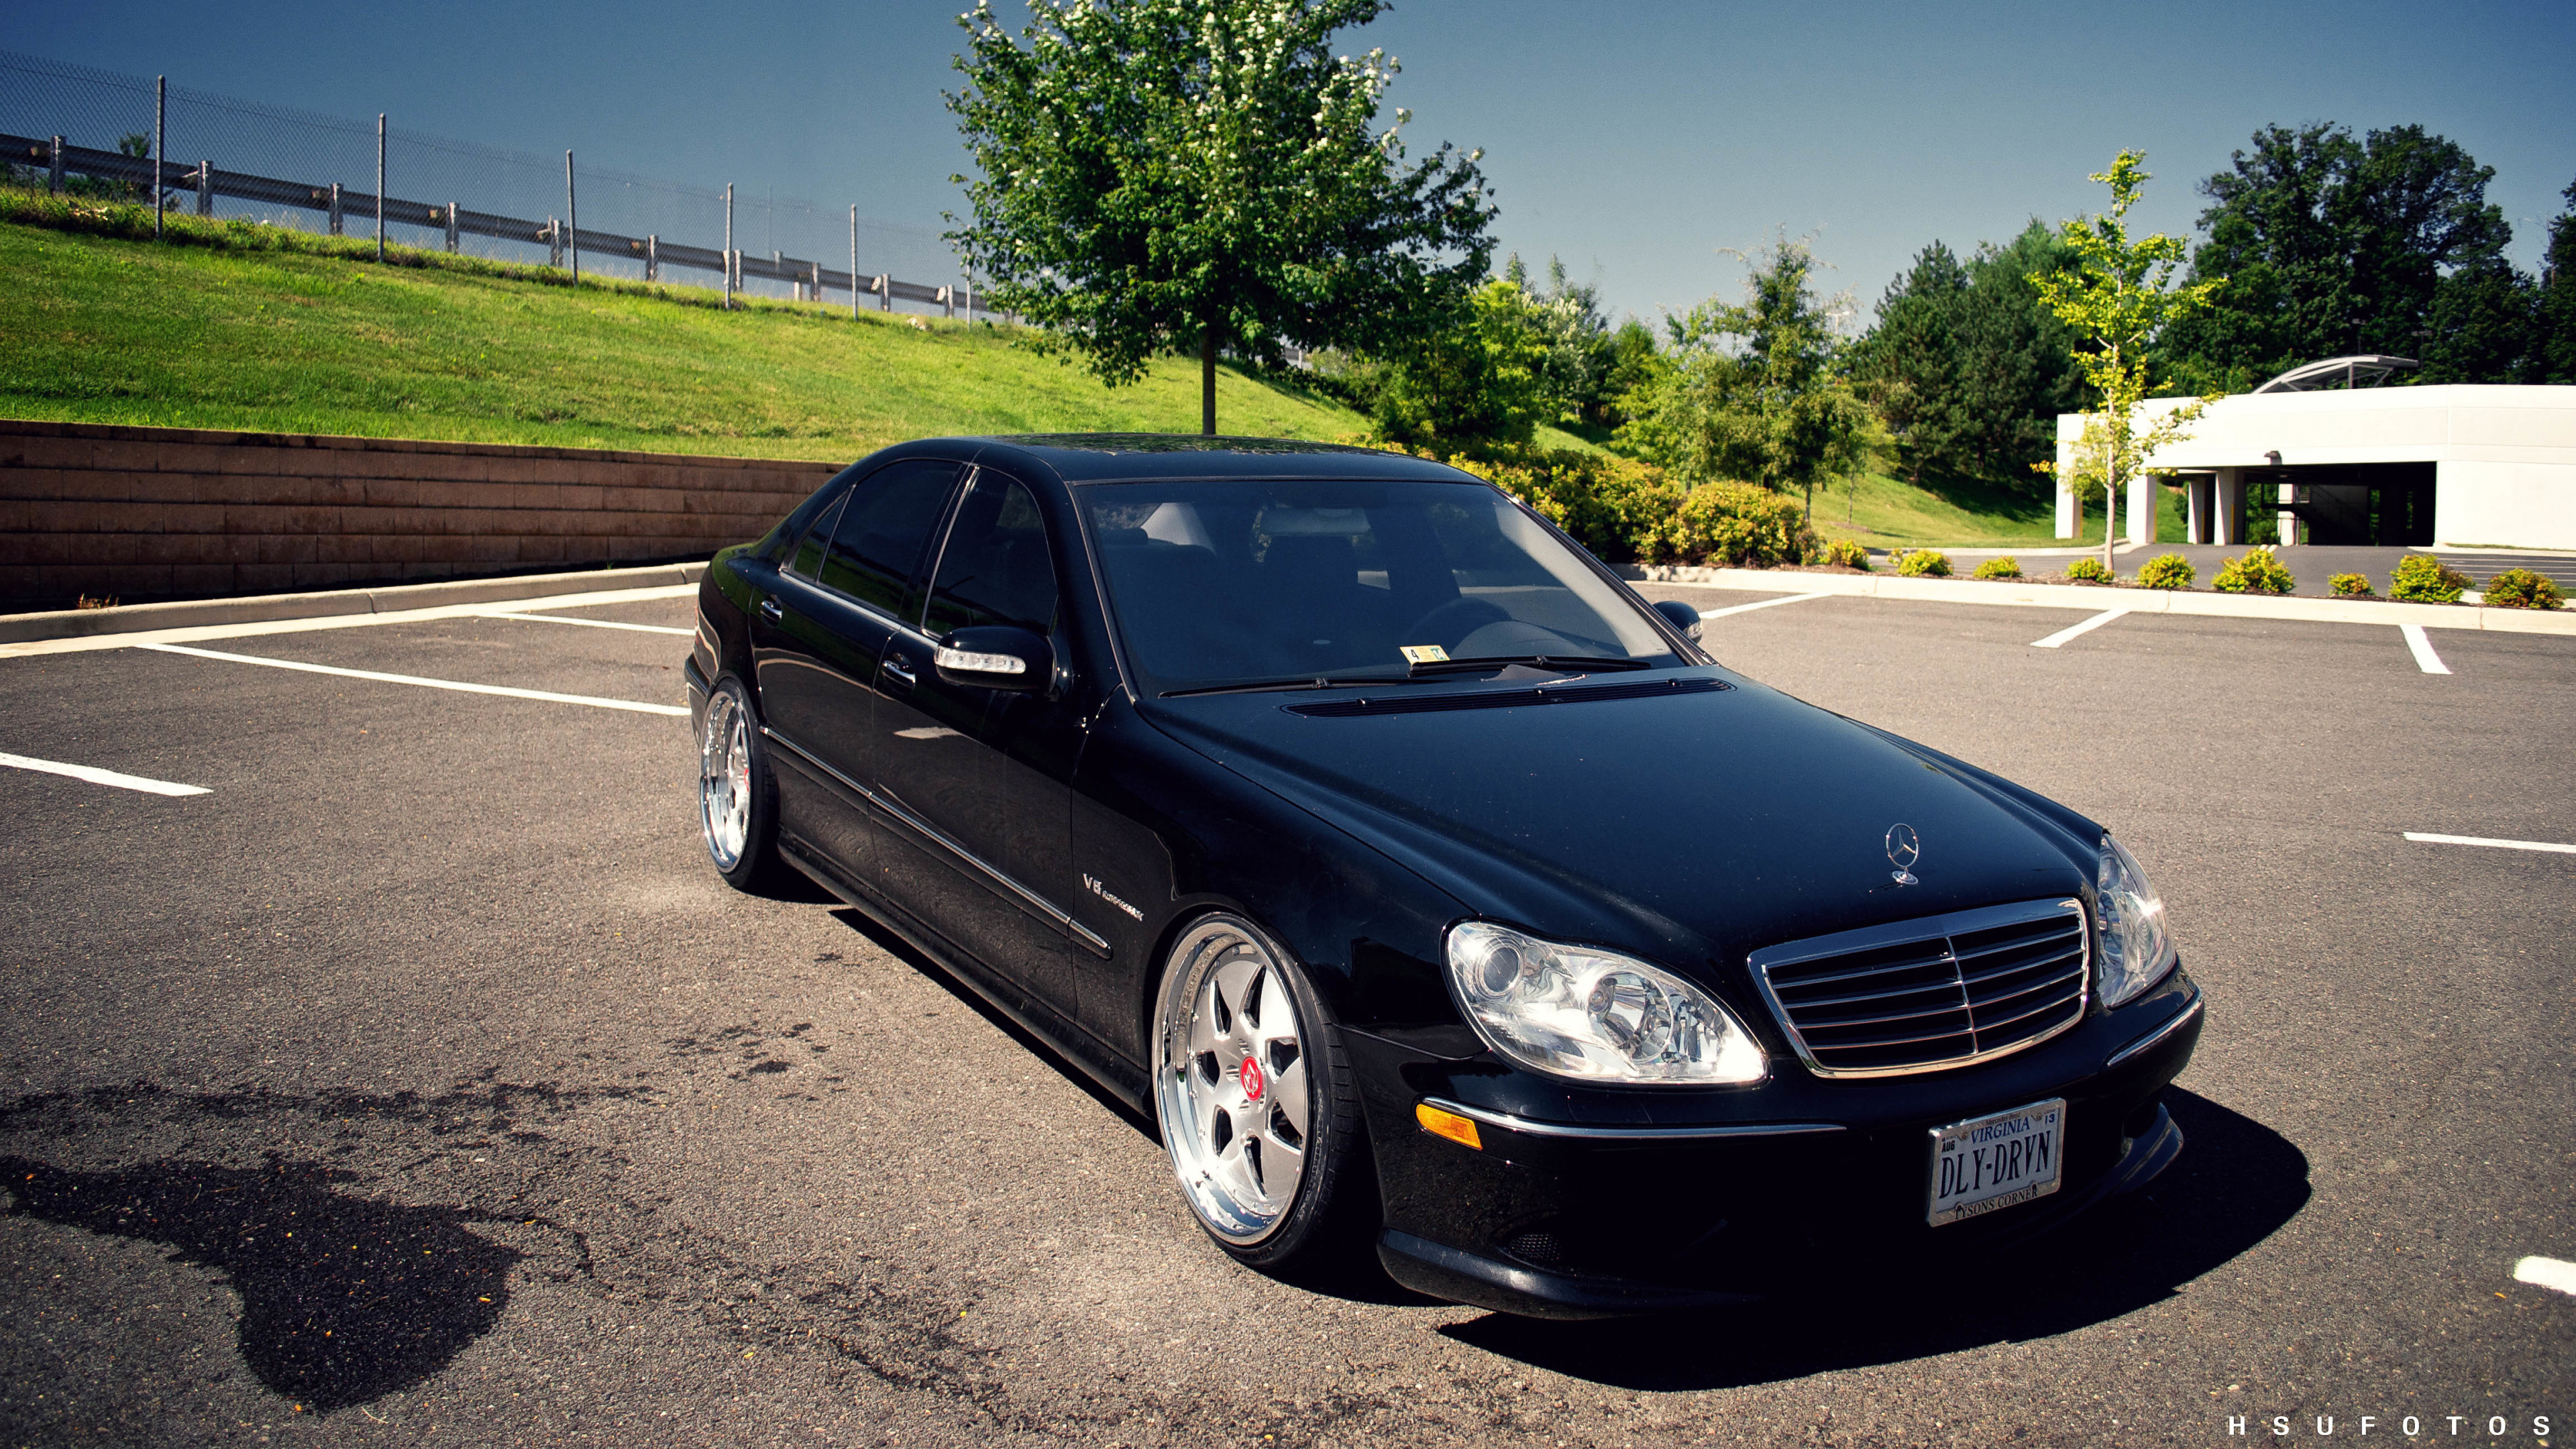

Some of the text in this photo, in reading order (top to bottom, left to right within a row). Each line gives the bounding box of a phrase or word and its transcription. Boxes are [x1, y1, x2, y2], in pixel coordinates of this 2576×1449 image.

[1971, 1116, 2030, 1144] VIRGINIA
[2045, 1113, 2055, 1124] 13
[1941, 1140, 1955, 1153] AUG
[1939, 1130, 2051, 1199] DLY-DRVN
[1954, 1188, 2038, 1220] TYSONS CORNER
